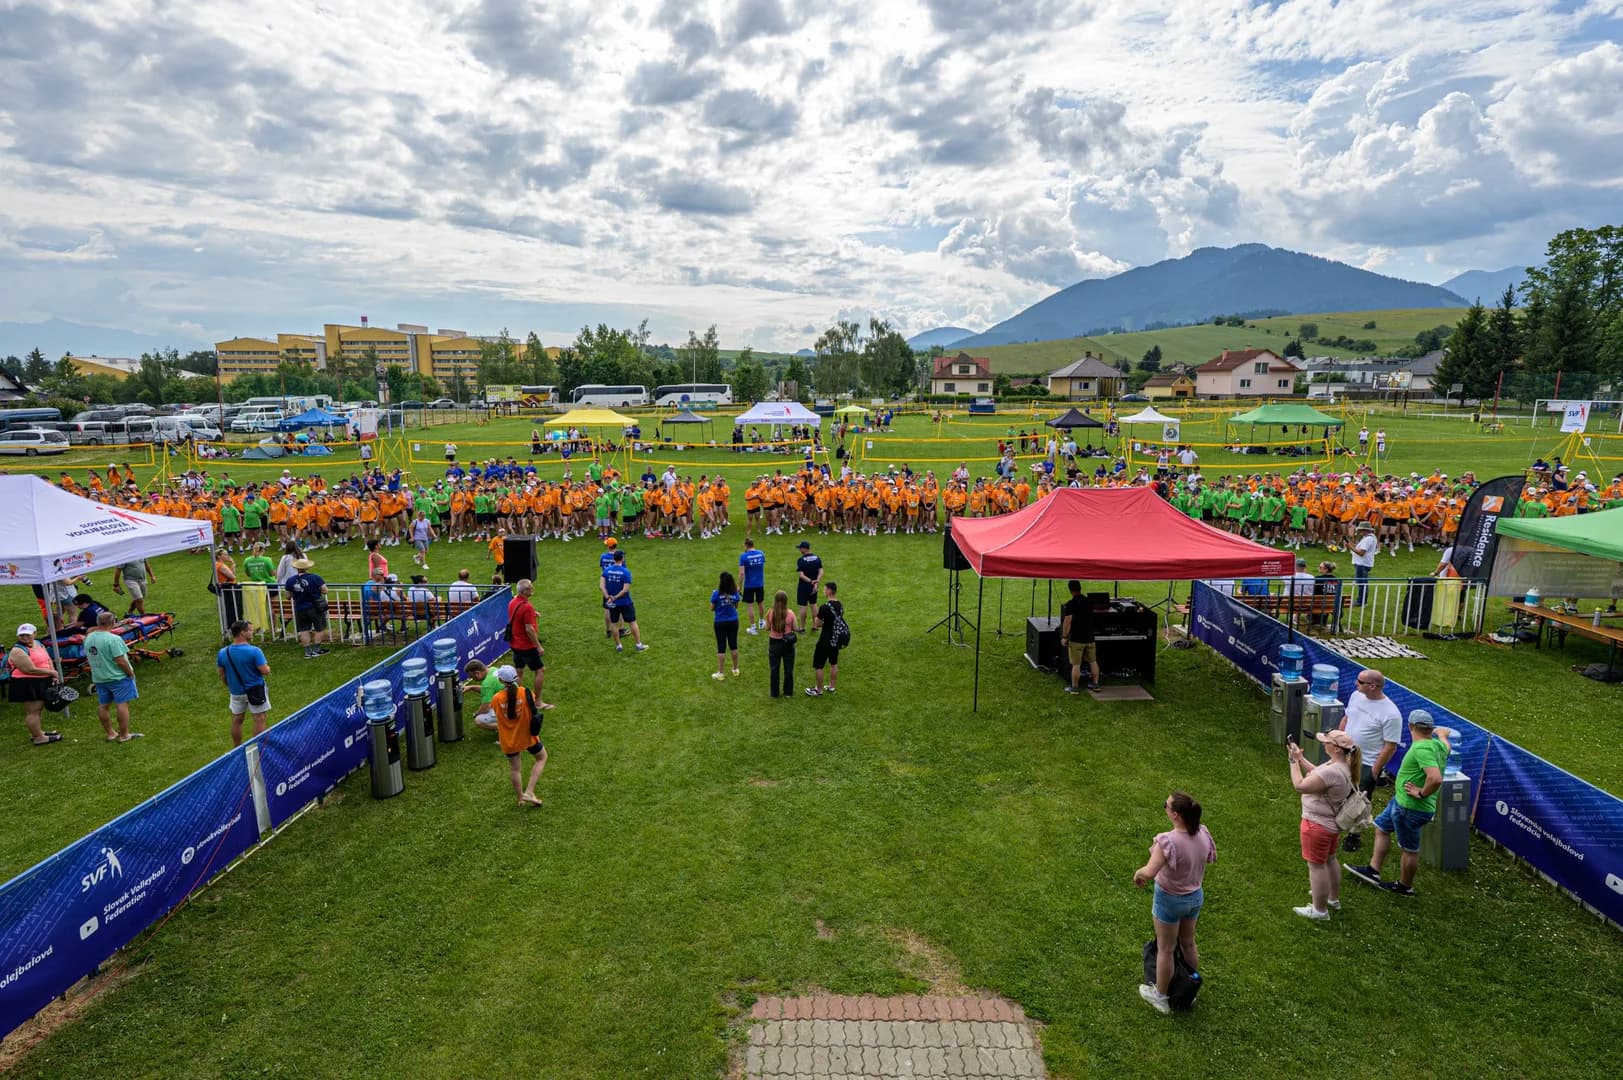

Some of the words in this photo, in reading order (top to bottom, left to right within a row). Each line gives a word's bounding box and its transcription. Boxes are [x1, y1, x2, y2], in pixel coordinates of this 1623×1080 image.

[1472, 514, 1497, 567] Residence
[1509, 814, 1542, 840] federácia
[1511, 807, 1542, 832] Slovenská
[1542, 830, 1585, 861] volejbalová
[81, 863, 108, 893] SVF
[103, 891, 130, 915] Slovak
[130, 864, 166, 896] Volleyball
[105, 890, 146, 925] Federation
